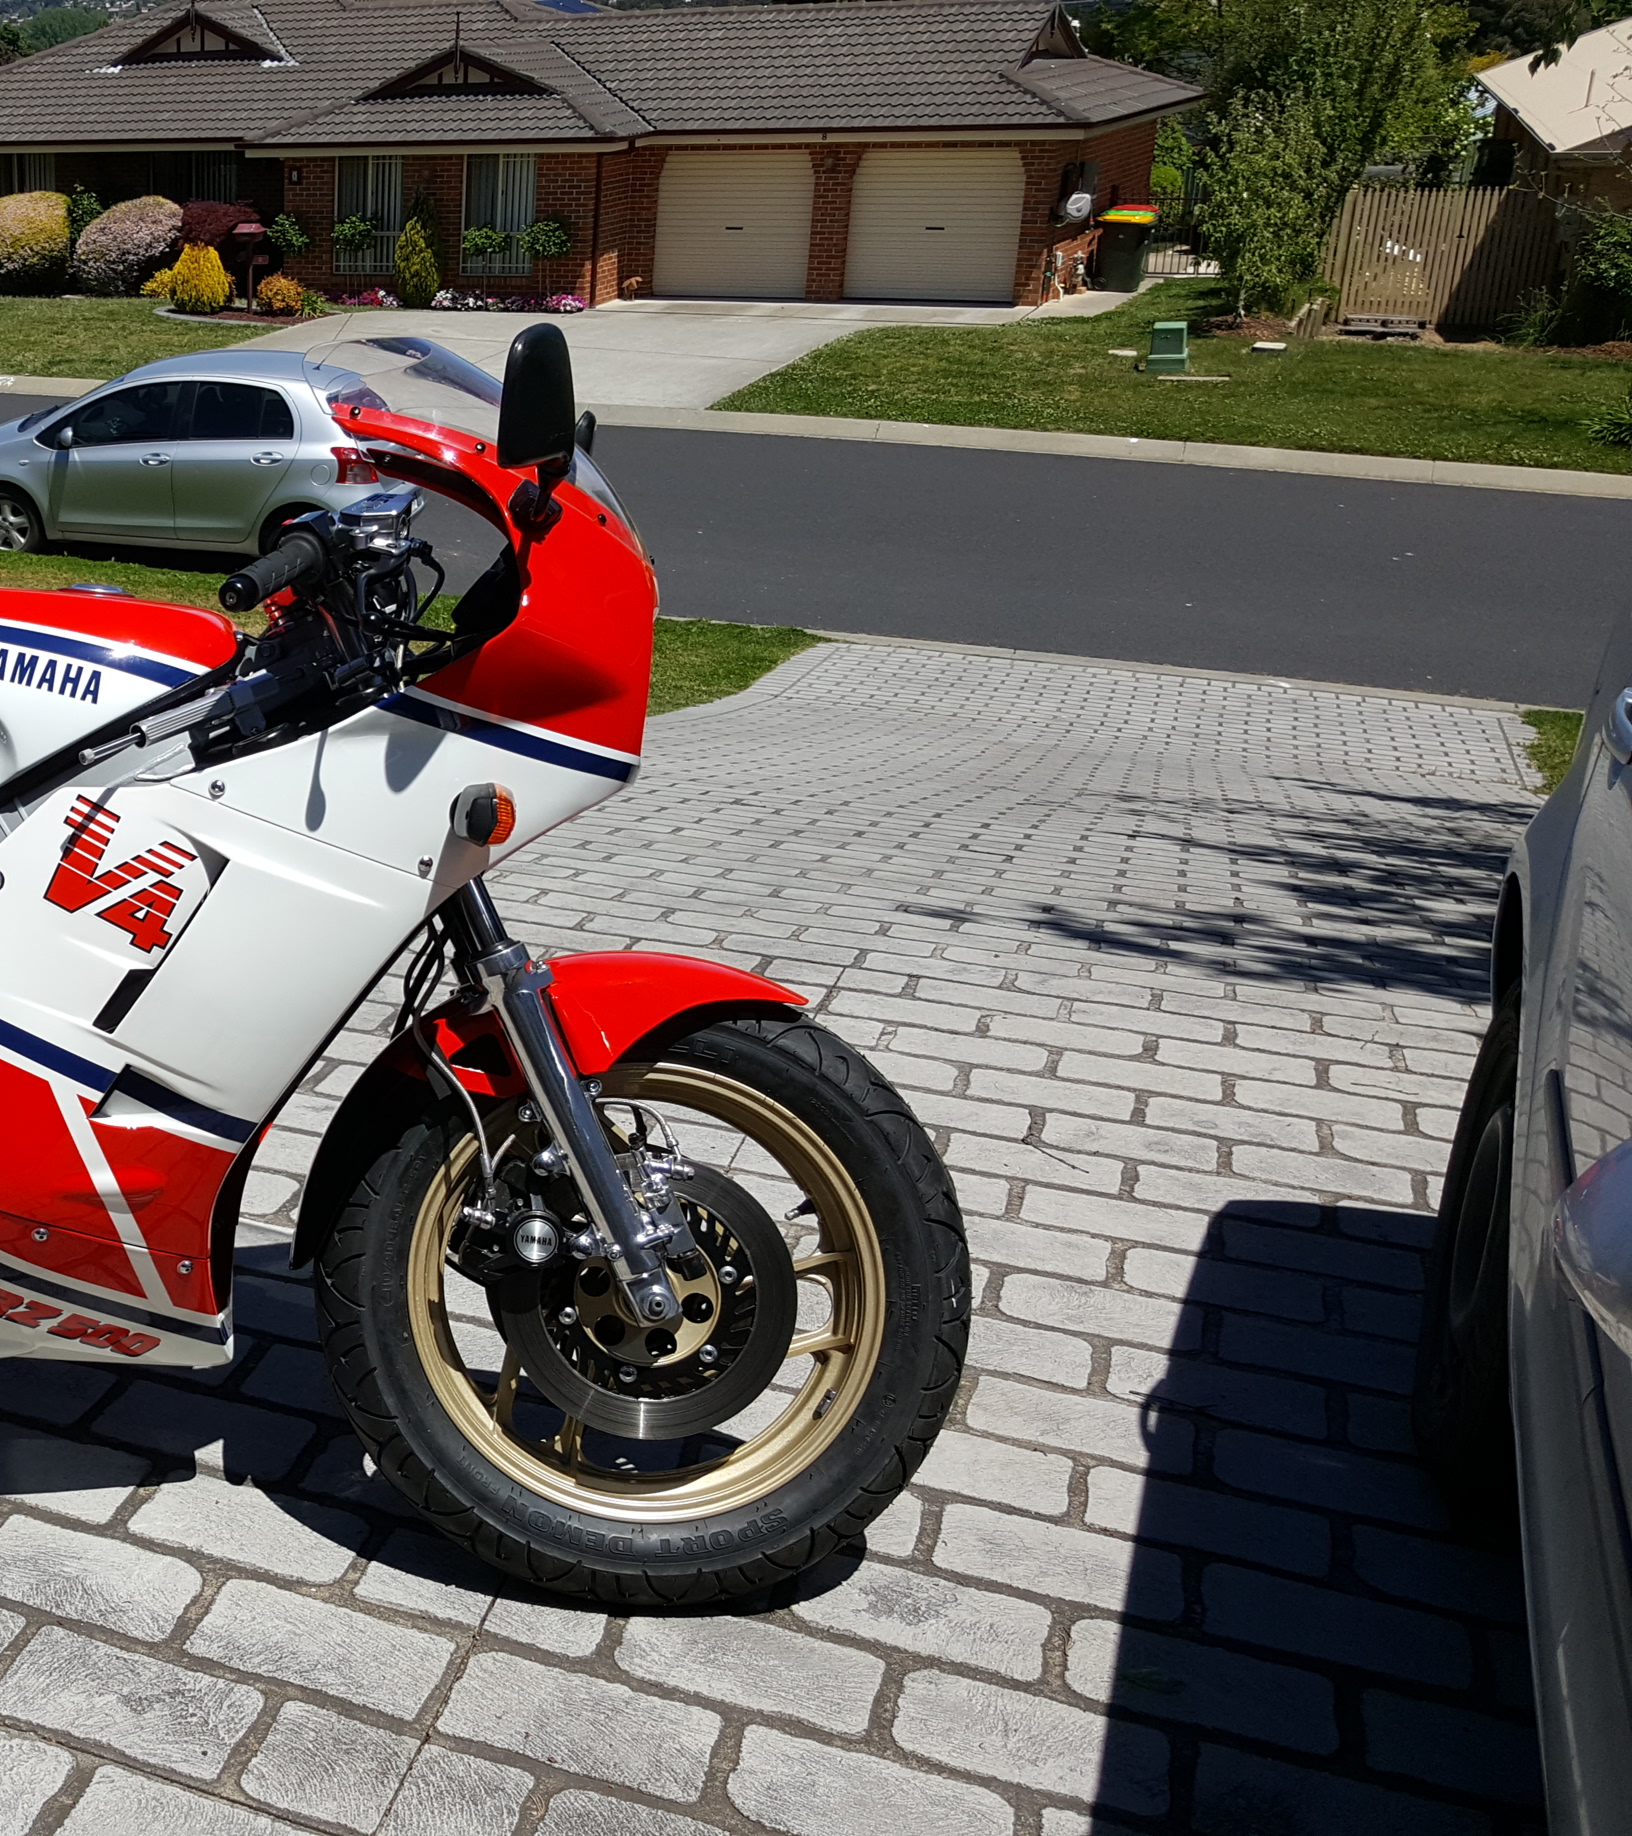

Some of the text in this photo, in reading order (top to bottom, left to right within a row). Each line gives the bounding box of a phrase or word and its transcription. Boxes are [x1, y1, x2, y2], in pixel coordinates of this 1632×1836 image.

[43, 794, 198, 954] V4
[520, 1234, 552, 1246] YAMAHA
[46, 1313, 161, 1357] 500
[501, 1495, 636, 1556] DEMON
[655, 1507, 790, 1558] SPORT
